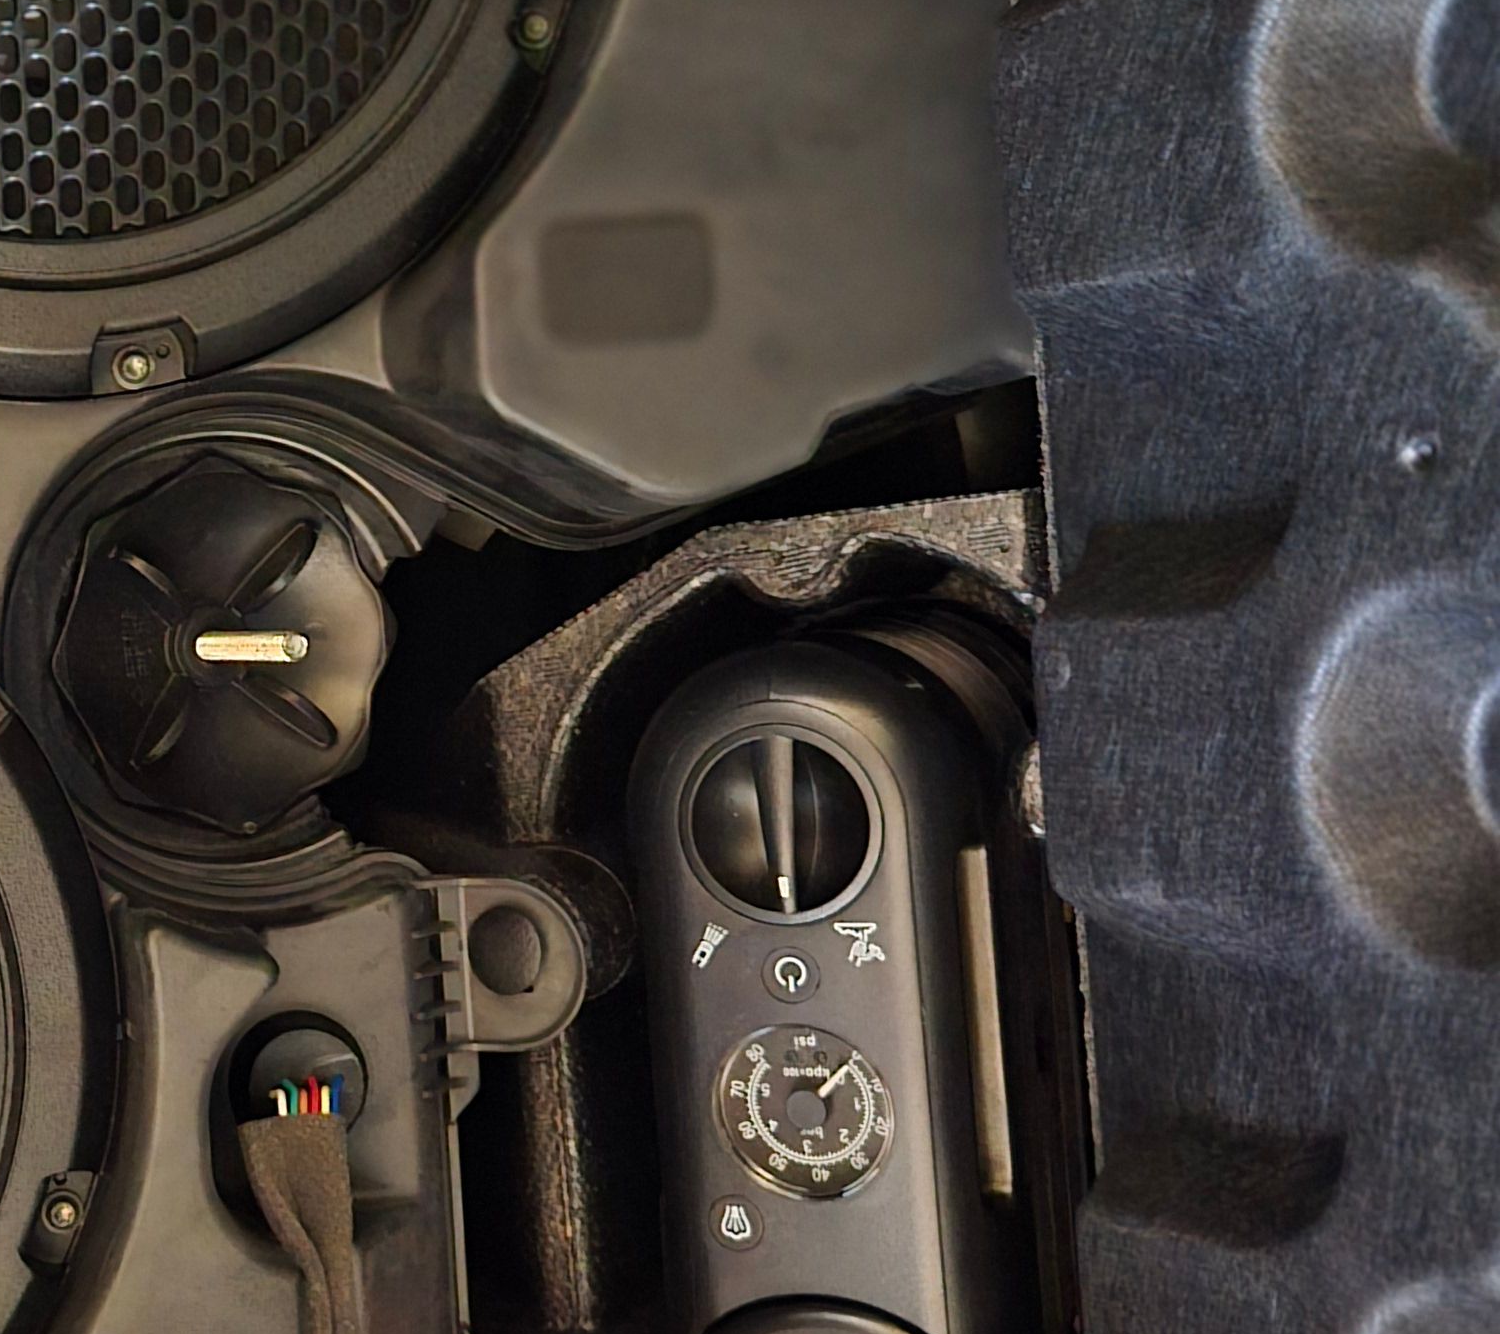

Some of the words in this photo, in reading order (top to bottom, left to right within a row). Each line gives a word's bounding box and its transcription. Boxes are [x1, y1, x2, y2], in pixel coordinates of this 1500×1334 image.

[794, 1033, 816, 1050] psi
[730, 1080, 745, 1098] 70
[761, 1084, 770, 1097] 5
[854, 1098, 861, 1111] 1
[738, 1121, 755, 1139] 60
[769, 1119, 778, 1132] 4
[839, 1128, 849, 1142] 2
[803, 1140, 812, 1153] 3
[769, 1153, 788, 1170] 50
[850, 1152, 869, 1170] 30
[812, 1168, 830, 1182] 40
